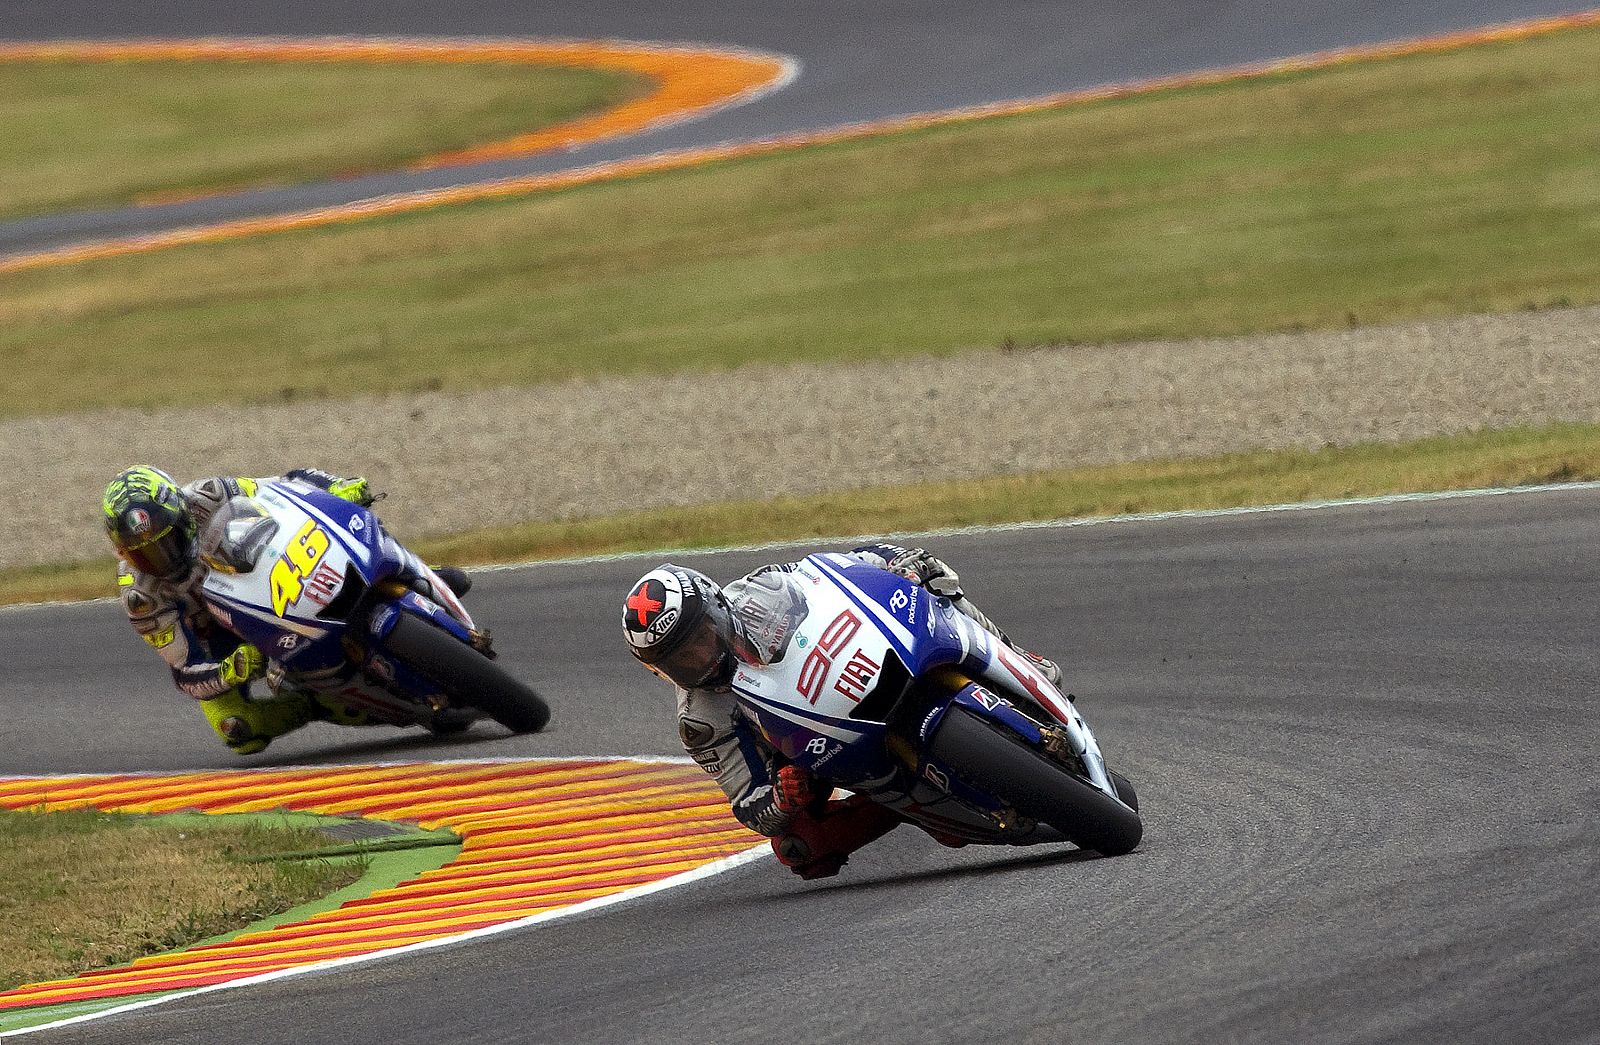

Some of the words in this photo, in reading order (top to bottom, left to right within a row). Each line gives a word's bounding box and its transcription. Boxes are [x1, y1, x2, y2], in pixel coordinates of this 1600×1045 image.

[269, 517, 331, 620] 46
[303, 561, 345, 606] FIAT
[796, 608, 863, 706] 99
[833, 647, 881, 703] FIAT
